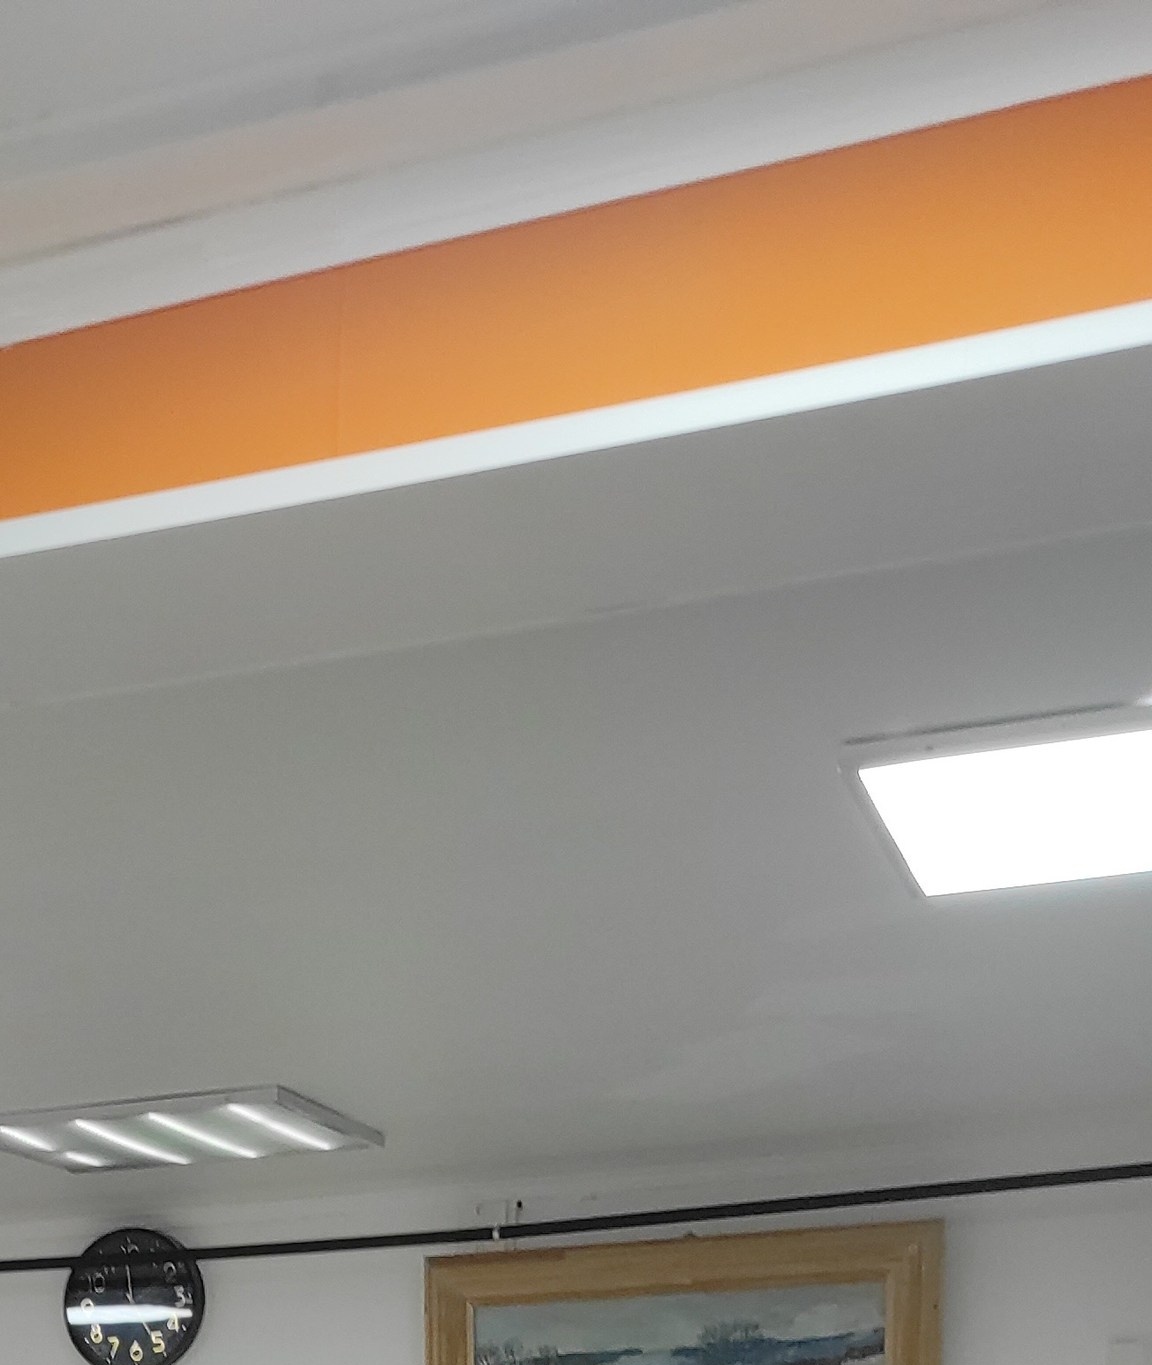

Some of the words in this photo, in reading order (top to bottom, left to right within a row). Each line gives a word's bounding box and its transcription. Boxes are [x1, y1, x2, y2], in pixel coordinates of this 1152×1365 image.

[174, 1285, 186, 1308] 3
[90, 1324, 103, 1344] 8
[151, 1330, 166, 1353] 5
[107, 1336, 120, 1359] 7
[129, 1340, 144, 1362] 6
